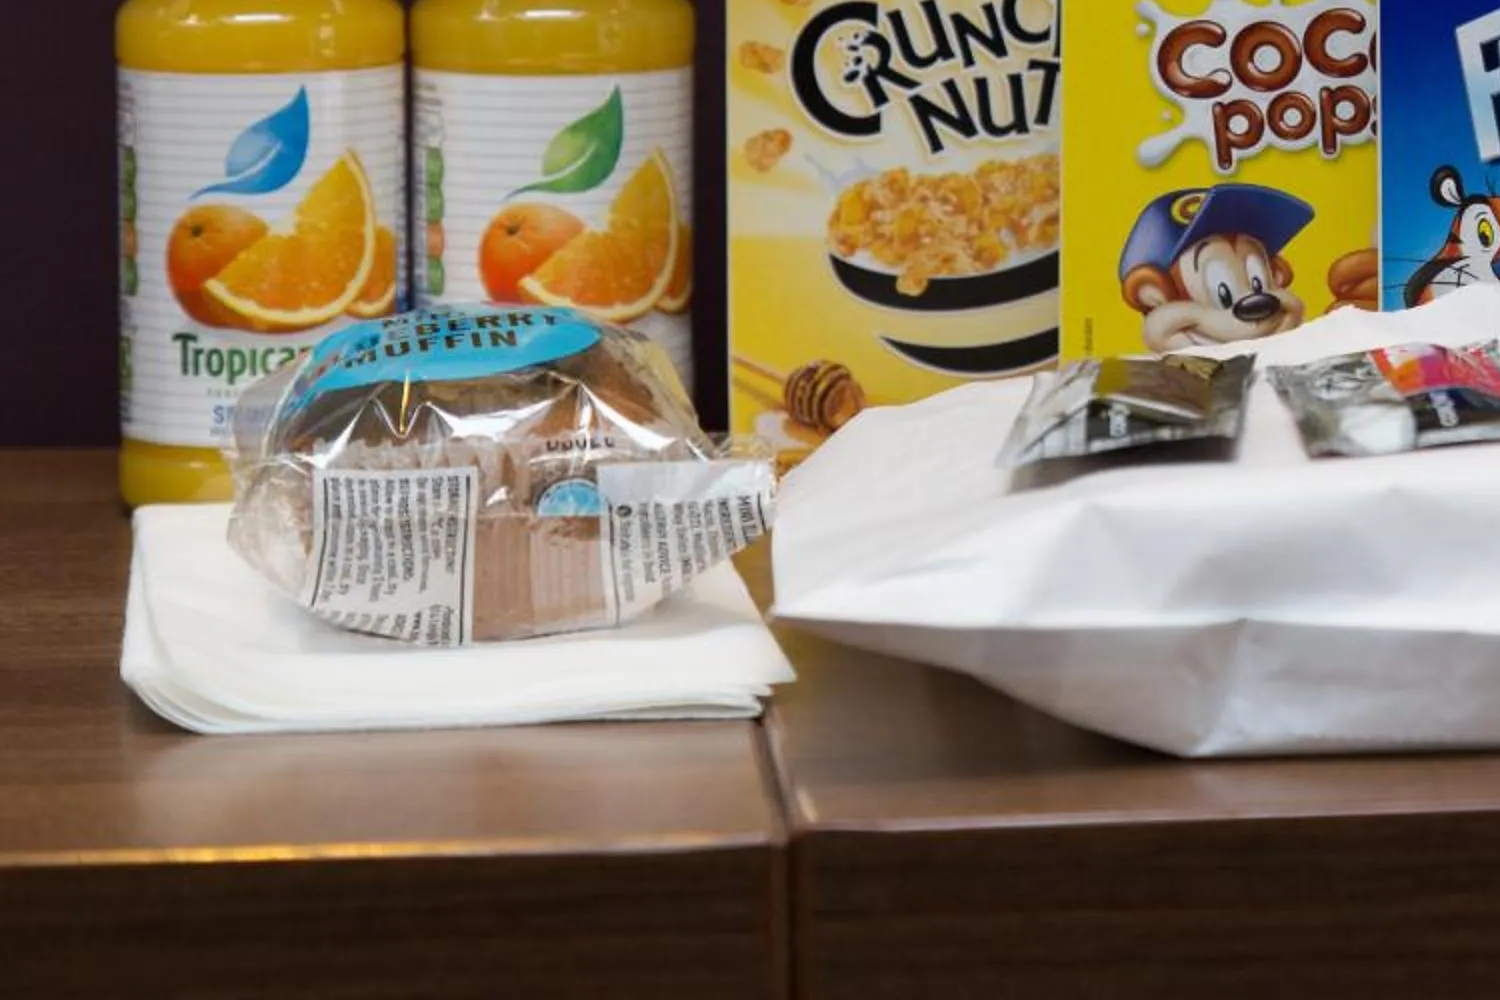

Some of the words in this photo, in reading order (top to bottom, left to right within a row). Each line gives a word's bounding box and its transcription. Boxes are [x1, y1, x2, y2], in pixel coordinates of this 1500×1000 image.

[1157, 8, 1377, 99] COC
[908, 59, 1060, 154] NUT
[1213, 85, 1377, 171] pop
[172, 332, 312, 385] Tropica
